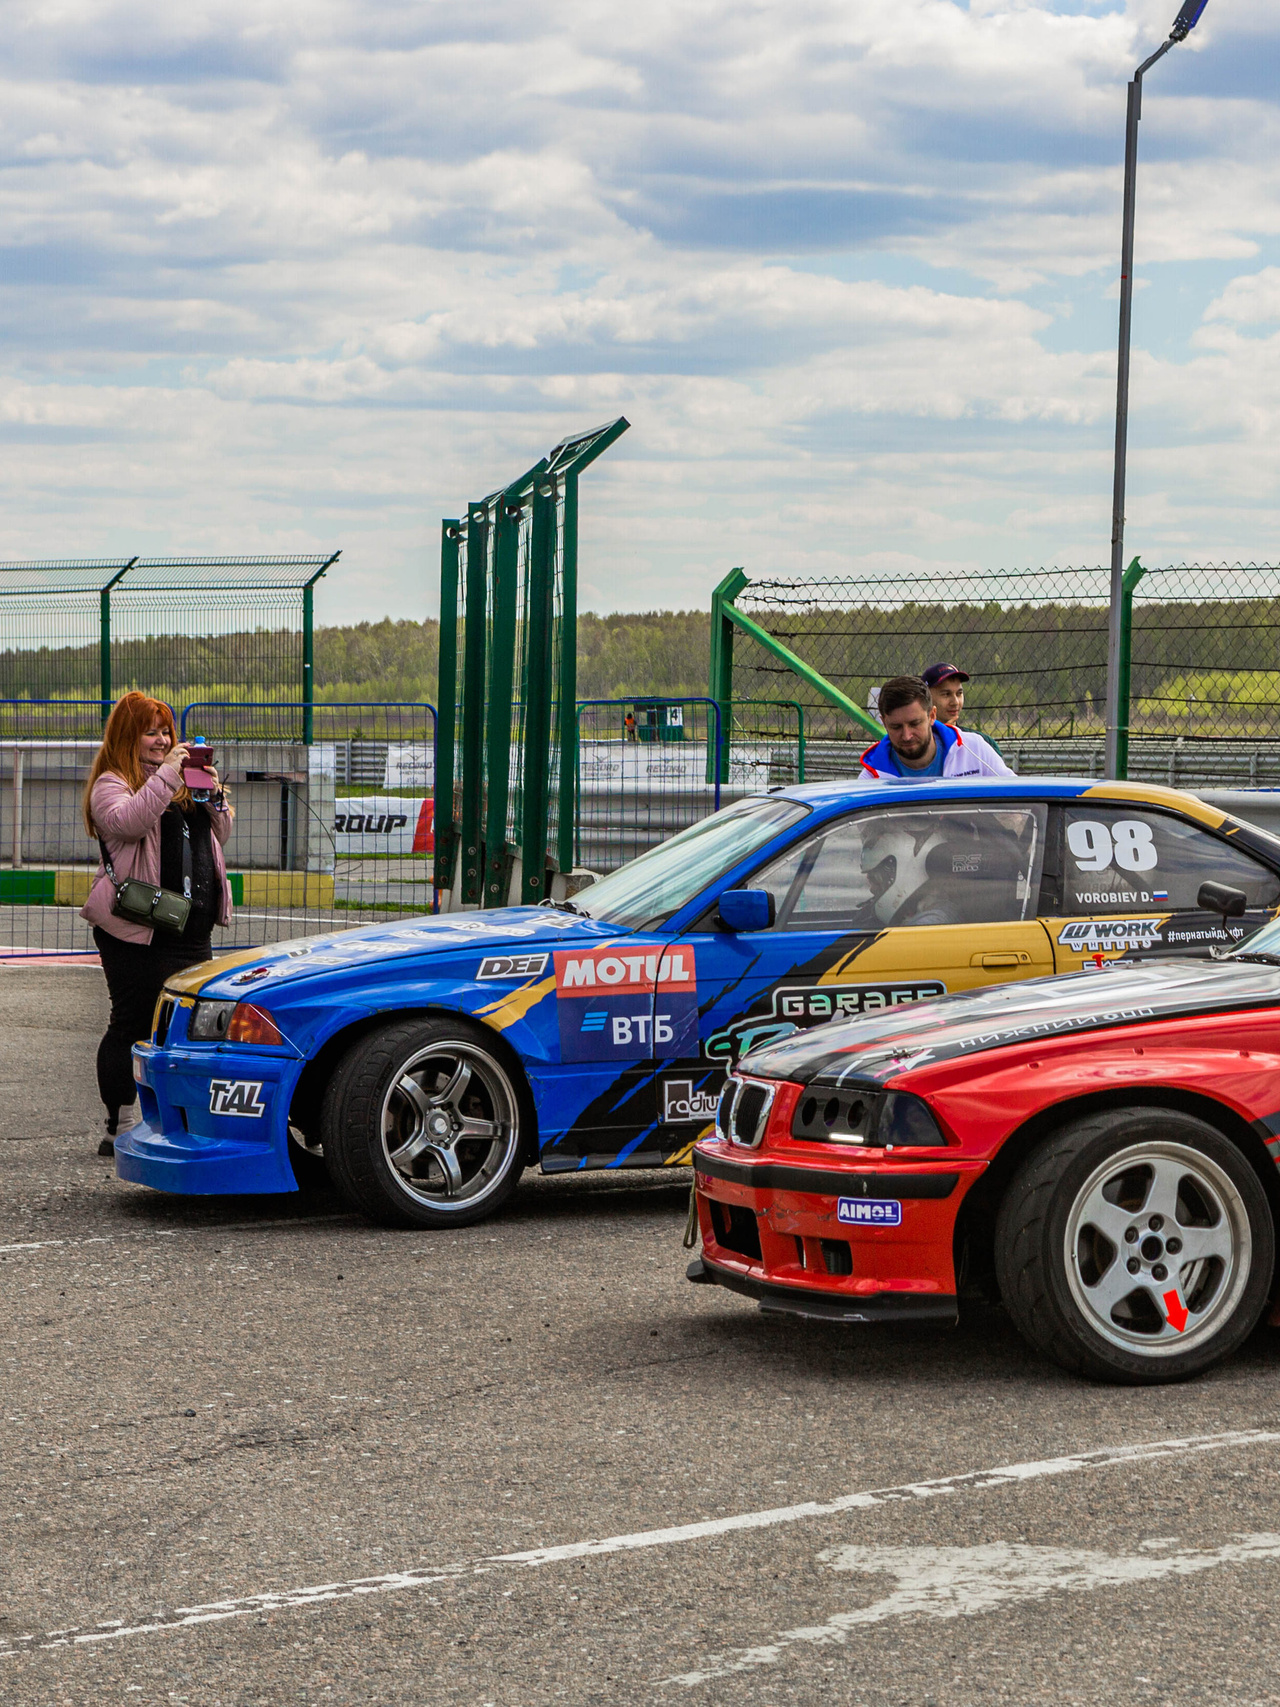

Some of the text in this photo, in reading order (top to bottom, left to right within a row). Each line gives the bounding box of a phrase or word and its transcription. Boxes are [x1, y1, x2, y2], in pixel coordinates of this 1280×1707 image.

[671, 708, 678, 721] 4
[1066, 819, 1158, 872] 98
[1075, 891, 1154, 904] VOROBIEV D.
[1093, 921, 1157, 937] WORK
[1072, 939, 1151, 950] WHEELS
[562, 954, 690, 987] MOTUL
[612, 1014, 674, 1045] ВТБ
[838, 1201, 897, 1220] AIMOL
